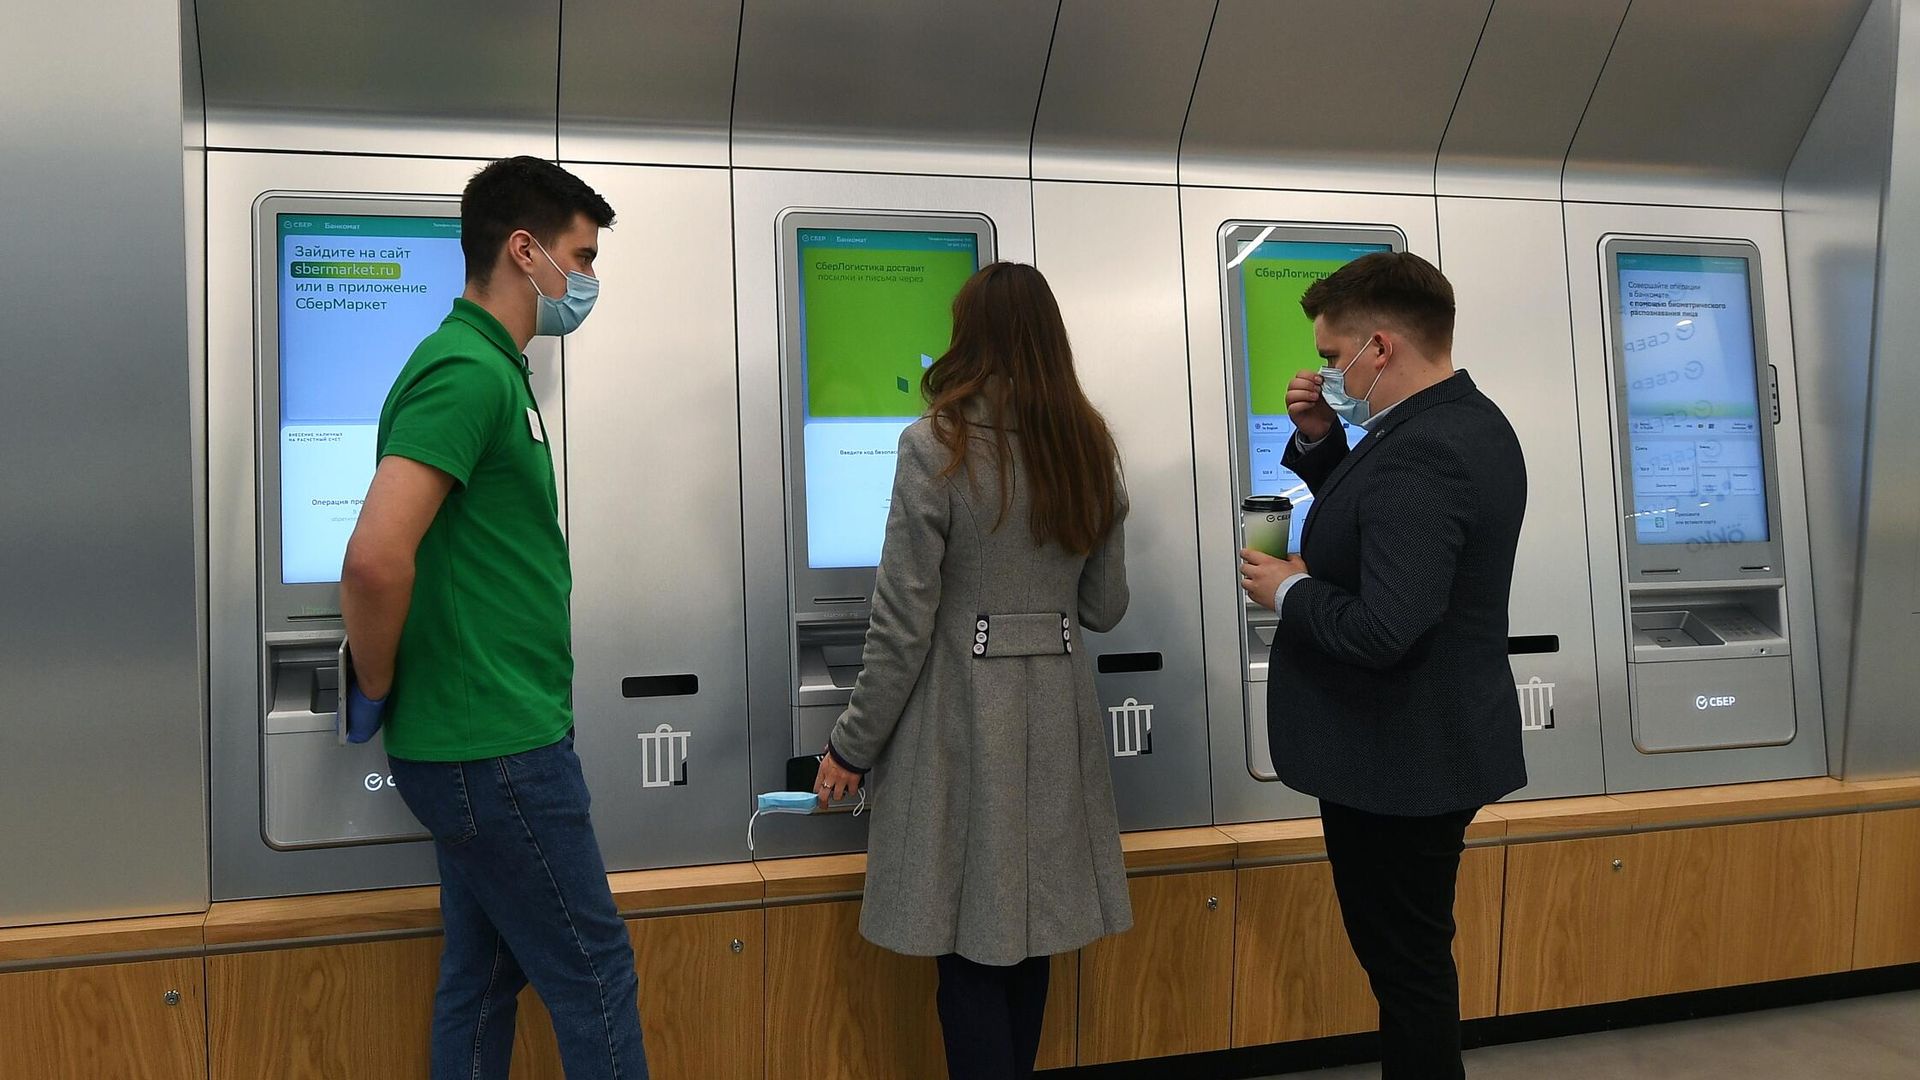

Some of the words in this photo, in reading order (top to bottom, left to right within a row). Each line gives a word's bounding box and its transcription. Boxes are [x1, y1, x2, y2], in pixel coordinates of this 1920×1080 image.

[295, 246, 355, 259] Зайдите
[359, 249, 376, 258] на
[380, 247, 411, 259] сайт
[295, 263, 394, 276] sbermarket.ru
[816, 262, 884, 272] СберЛогистика
[886, 264, 924, 273] доставит
[296, 283, 322, 292] или
[326, 284, 334, 292] в
[338, 284, 428, 295] приложение
[1628, 282, 1669, 290] Совершайте
[296, 298, 388, 312] СберМаркет
[1709, 696, 1736, 706] СБЕР
